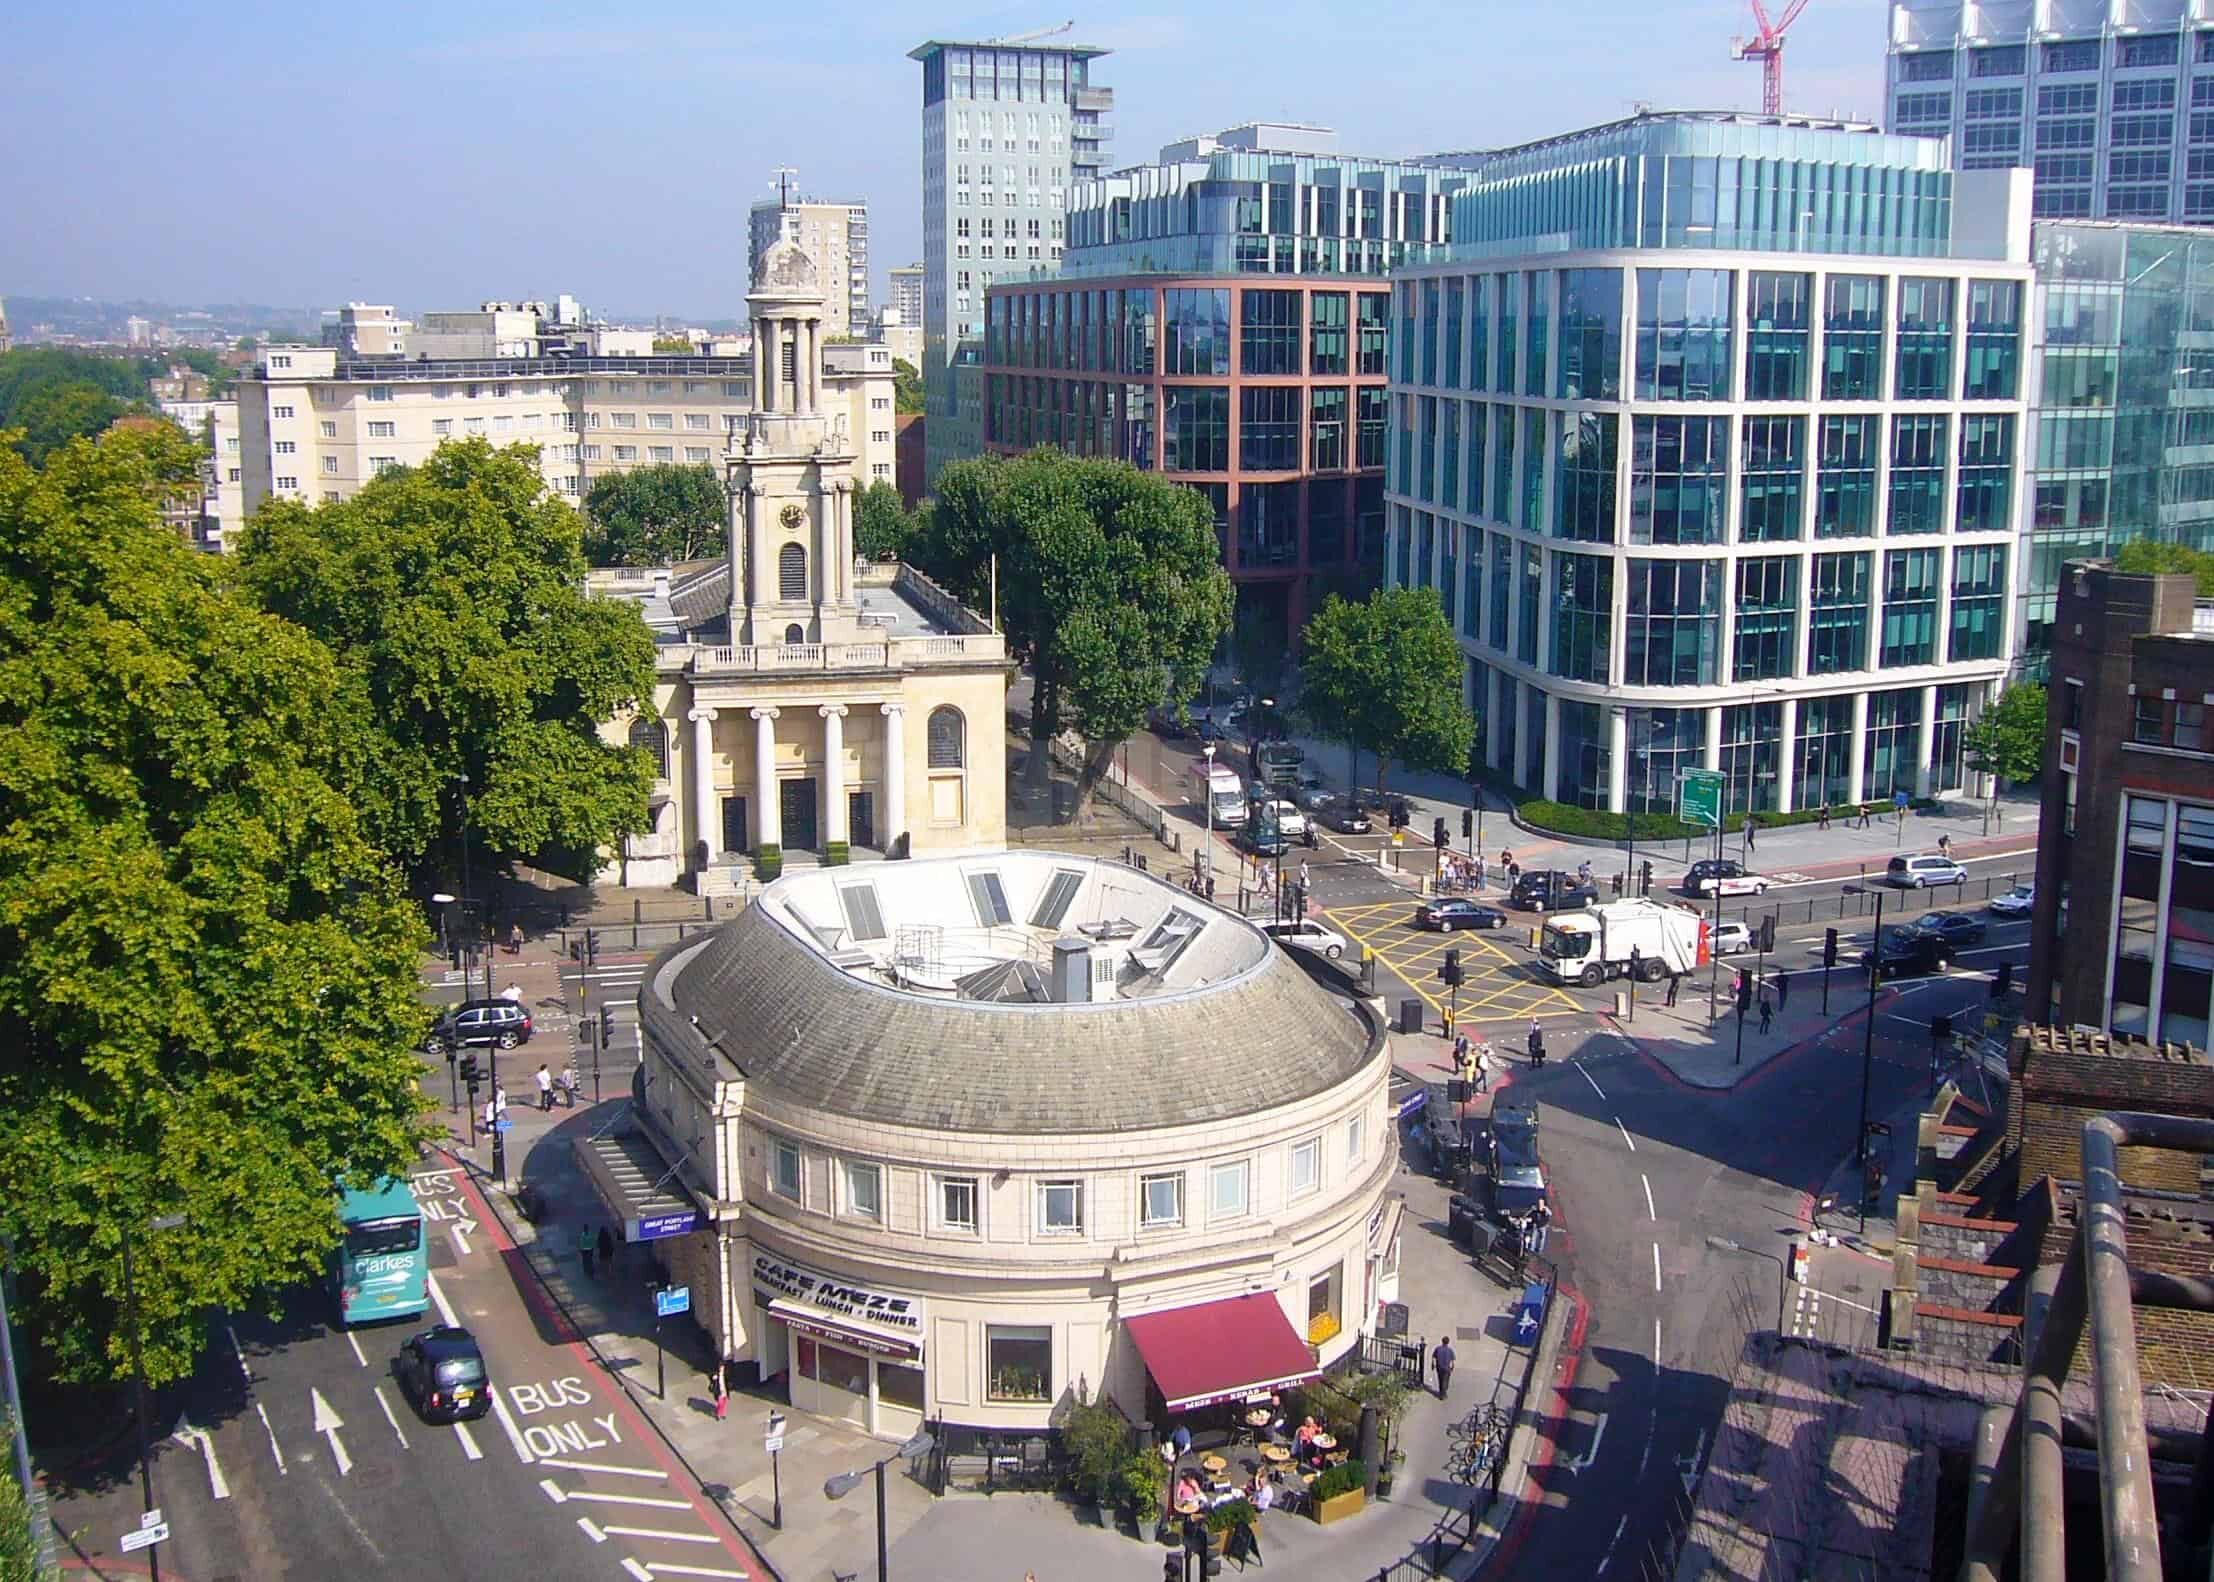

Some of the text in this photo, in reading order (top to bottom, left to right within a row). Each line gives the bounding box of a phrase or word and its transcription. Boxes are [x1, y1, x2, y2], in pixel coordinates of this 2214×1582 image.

[355, 1255, 415, 1275] clarkes
[755, 1257, 911, 1313] CAFE MEZE
[815, 1296, 853, 1315] LUNCH
[866, 1310, 918, 1328] DINNER
[508, 1376, 592, 1416] BUS
[523, 1412, 622, 1458] ONLY
